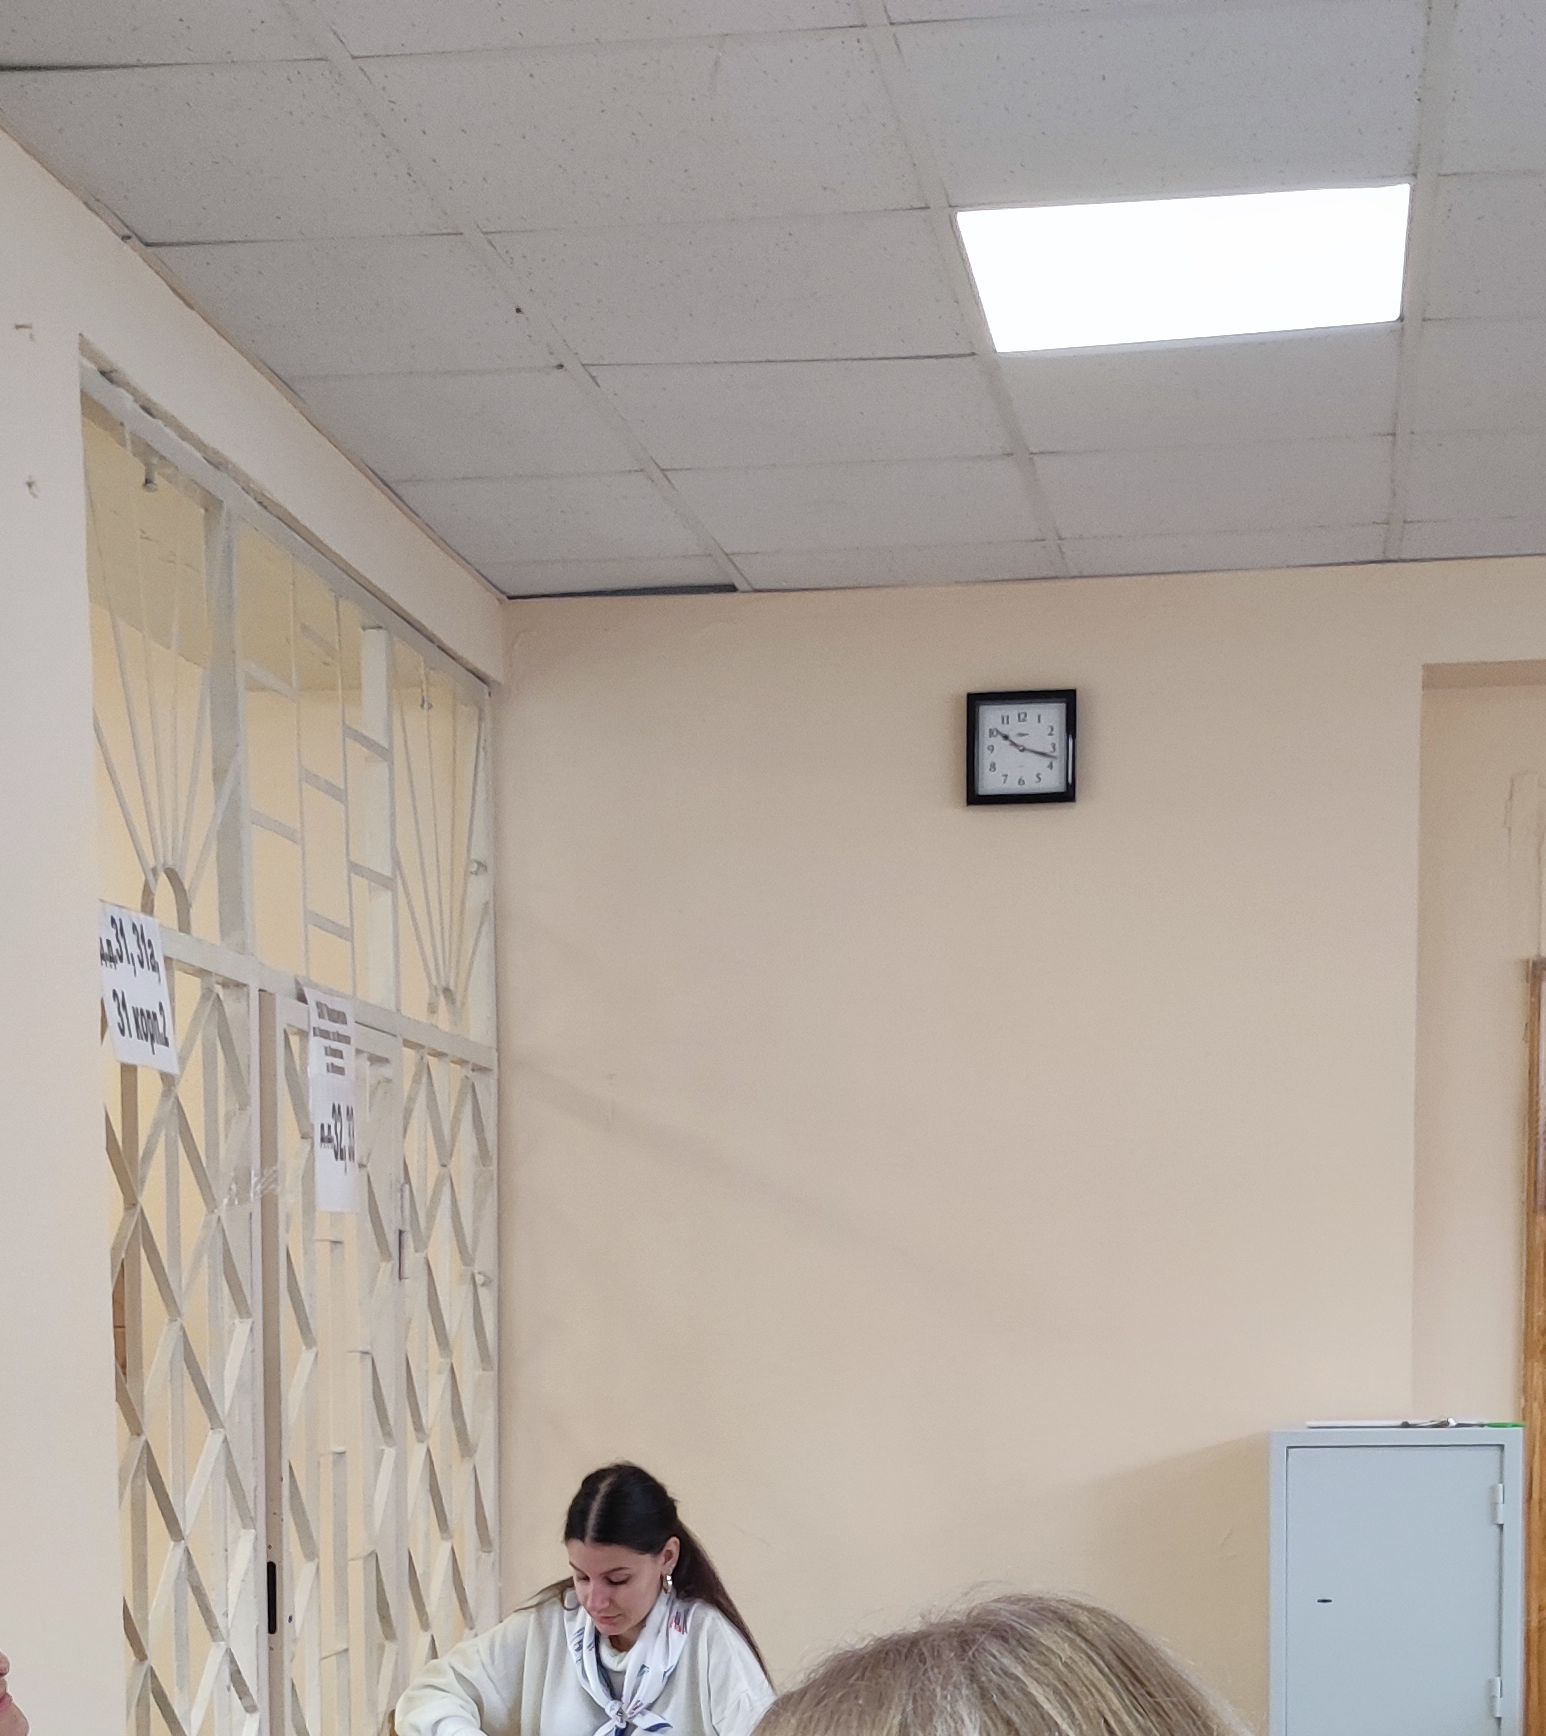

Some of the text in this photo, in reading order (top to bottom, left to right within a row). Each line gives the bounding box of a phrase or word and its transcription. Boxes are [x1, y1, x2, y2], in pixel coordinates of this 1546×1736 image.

[1001, 714, 1010, 725] 11
[1017, 711, 1027, 722] 12
[1038, 714, 1041, 723] 1
[1047, 726, 1054, 736] 2
[987, 744, 995, 753] 9
[1051, 743, 1056, 753] 3
[989, 762, 996, 772] 8
[1047, 761, 1053, 770] 4
[1001, 774, 1008, 784] 7
[1017, 776, 1025, 786] 6
[1035, 773, 1041, 783] 5
[112, 988, 132, 1038] 31
